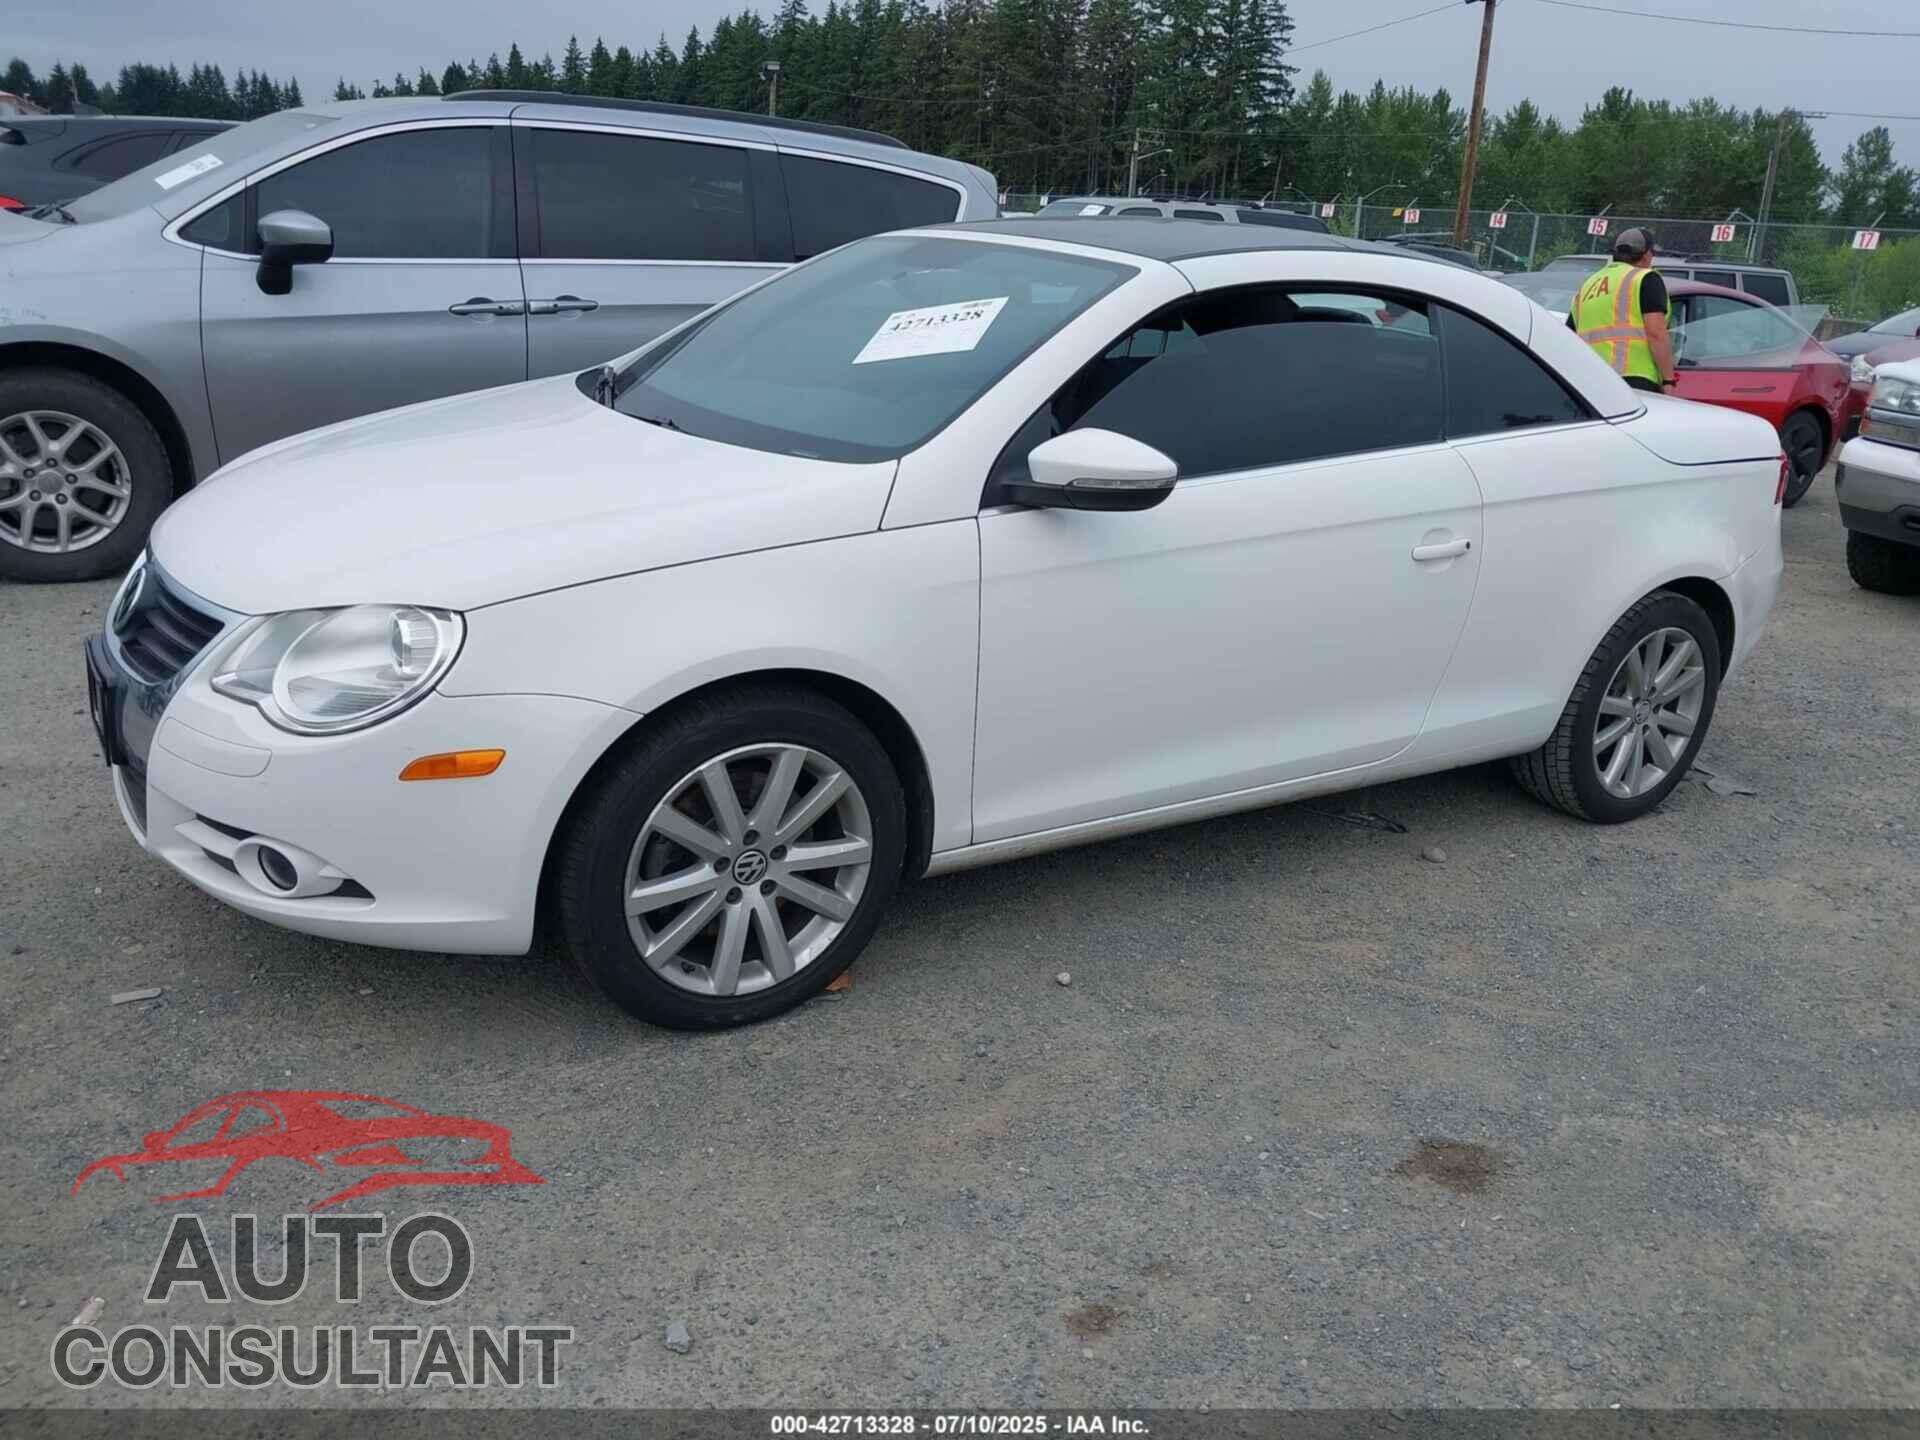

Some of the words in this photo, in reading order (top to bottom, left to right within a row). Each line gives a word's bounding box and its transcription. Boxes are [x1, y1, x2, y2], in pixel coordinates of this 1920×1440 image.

[1492, 213, 1504, 226] 14
[1591, 219, 1604, 234] 15
[1715, 225, 1731, 241] 16
[1859, 232, 1874, 247] 17
